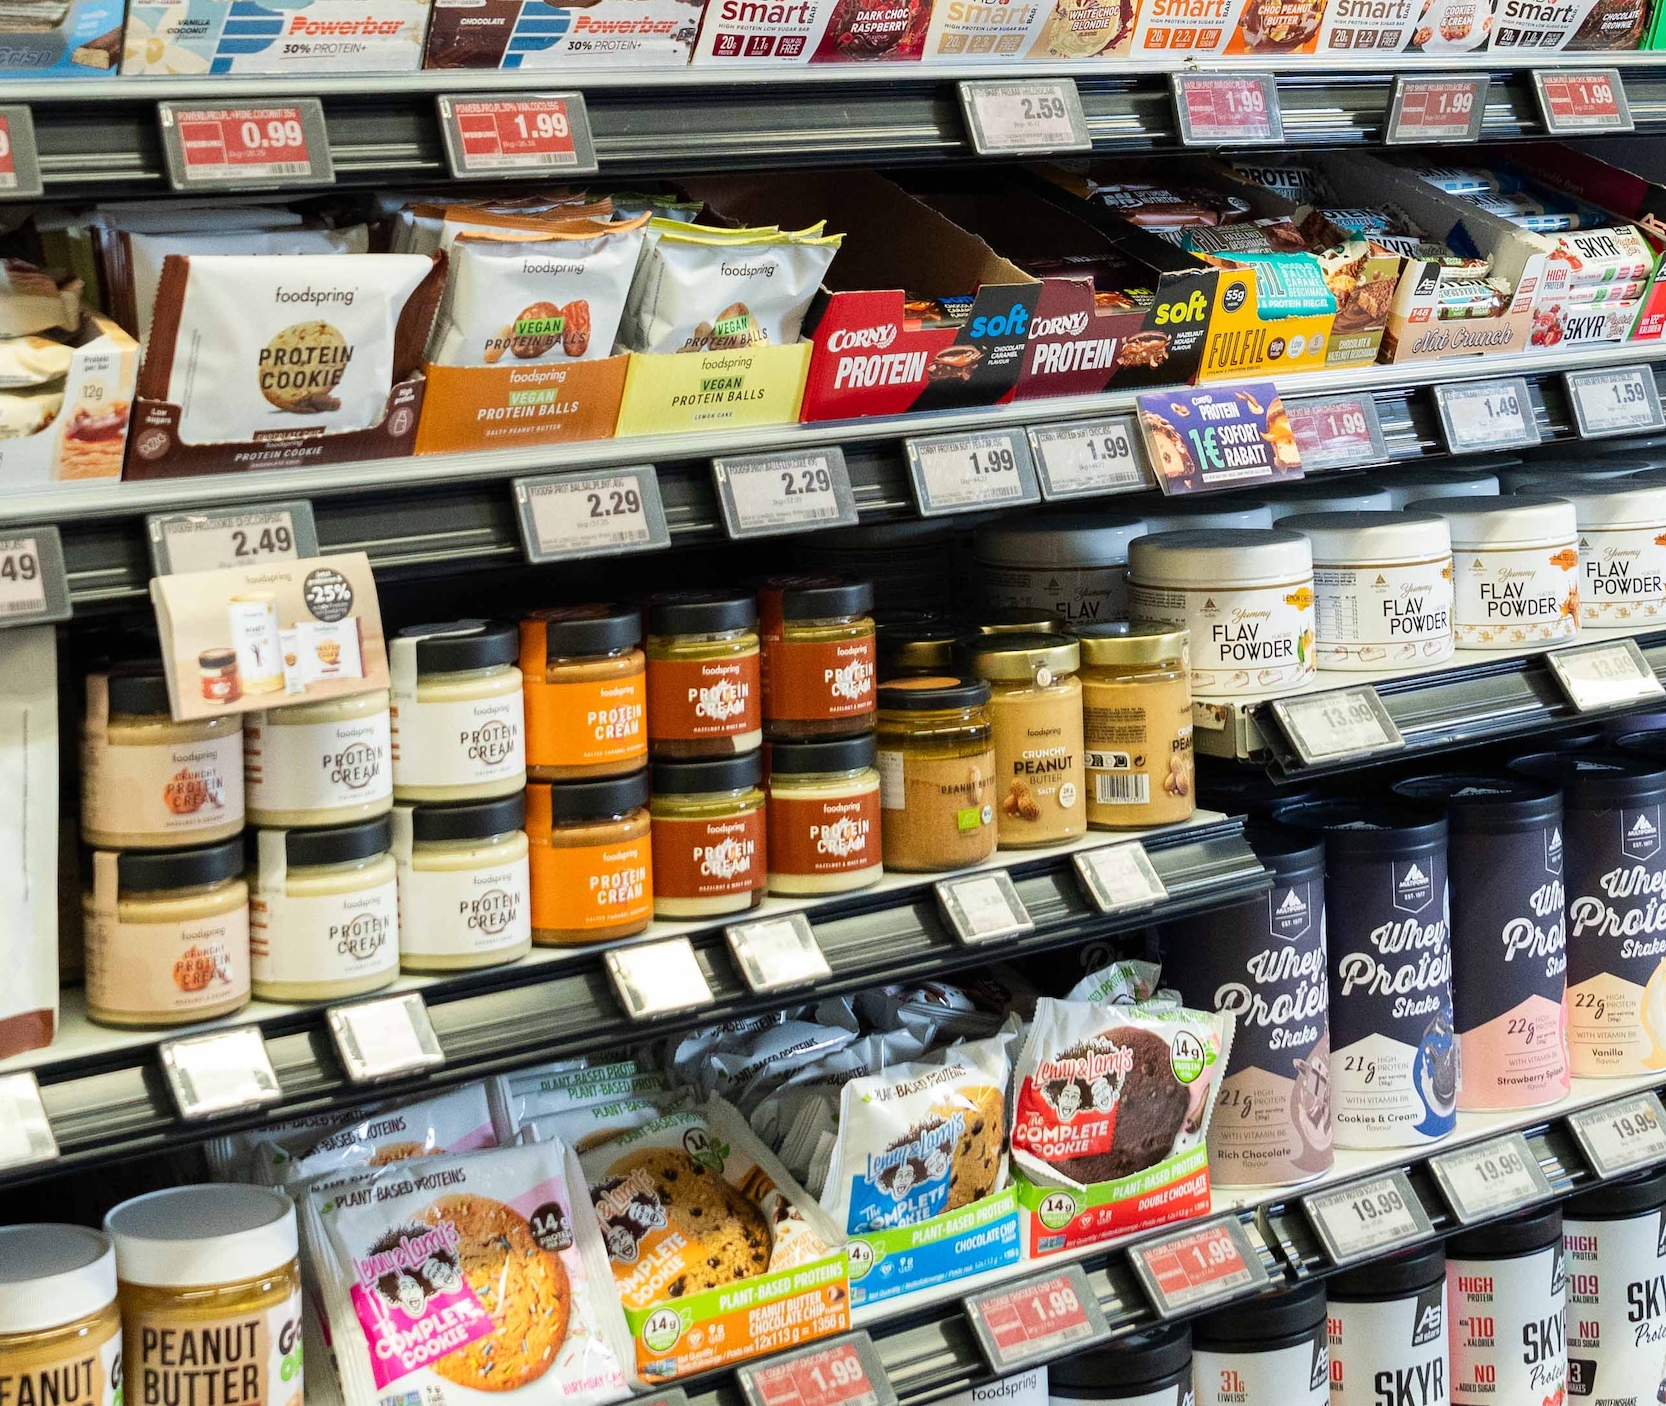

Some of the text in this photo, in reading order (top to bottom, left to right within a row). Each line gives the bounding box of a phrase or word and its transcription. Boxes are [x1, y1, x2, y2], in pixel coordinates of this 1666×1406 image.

[721, 1, 810, 24] smart
[857, 9, 908, 23] DARK CHOC
[1505, 1, 1569, 21] smart
[287, 16, 405, 38] Powerbar
[574, 16, 678, 35] Powerbar
[851, 21, 908, 33] RASPBERRY
[1072, 18, 1109, 32] BLONDIE
[568, 40, 642, 51] 30% PROTEIN+
[1578, 85, 1612, 105] 1.99
[1021, 98, 1065, 120] 2.59
[241, 122, 303, 149] 0.99
[1574, 238, 1615, 257] SKYR
[523, 260, 585, 275] foodspring
[275, 287, 354, 305] foodspring
[1225, 289, 1244, 304] 55g
[1155, 293, 1207, 324] soft
[517, 319, 562, 334] VEGAN
[970, 304, 1028, 338] soft
[1029, 312, 1088, 339] CORNY
[1565, 317, 1606, 341] SKYR
[829, 324, 895, 352] CORNY
[259, 345, 353, 365] PROTEIN
[1032, 339, 1116, 375] PROTEIN
[1209, 328, 1265, 369] FULFIL
[260, 368, 342, 389] COOKIE
[510, 368, 567, 383] foodspring
[835, 351, 926, 389] PROTEIN
[701, 377, 743, 390] VEGAN
[511, 390, 555, 404] VEGAN
[672, 389, 765, 407] PROTEIN BALLS
[1484, 395, 1519, 417] 1.49
[477, 400, 579, 420] PROTEIN BALLS
[1201, 401, 1239, 418] PROTEIN
[1221, 424, 1259, 445] SOFORT
[235, 445, 322, 462] PROTEIN COOKIE
[969, 452, 1013, 475] 1.99
[1224, 445, 1266, 466] RABATT
[587, 490, 639, 516] 2.29
[1213, 624, 1259, 642] FLAV
[1220, 639, 1293, 661] POWDER
[702, 665, 740, 676] foodspring
[588, 704, 641, 725] PROTEIN
[595, 722, 639, 739] CREAM
[1022, 746, 1066, 759] CRUNCHY
[1014, 757, 1072, 774] PEANUT
[1029, 772, 1063, 785] BUTTER
[1372, 921, 1445, 955] Whey
[1392, 997, 1440, 1019] Shake
[1592, 1048, 1622, 1059] Vanilla
[1338, 1114, 1376, 1124] Cookies
[1389, 1112, 1418, 1122] Cream
[1218, 1148, 1291, 1160] Rich Chocolate
[1113, 1167, 1171, 1198] PLANT-BASED
[1138, 1174, 1208, 1211] DOUBLE CHOCOLATE
[1353, 1192, 1403, 1222] 19.99
[1193, 1238, 1234, 1265] 1.99
[1459, 1278, 1493, 1293] HIGH
[142, 1320, 259, 1363] PEANUT
[143, 1364, 258, 1404] BUTTER
